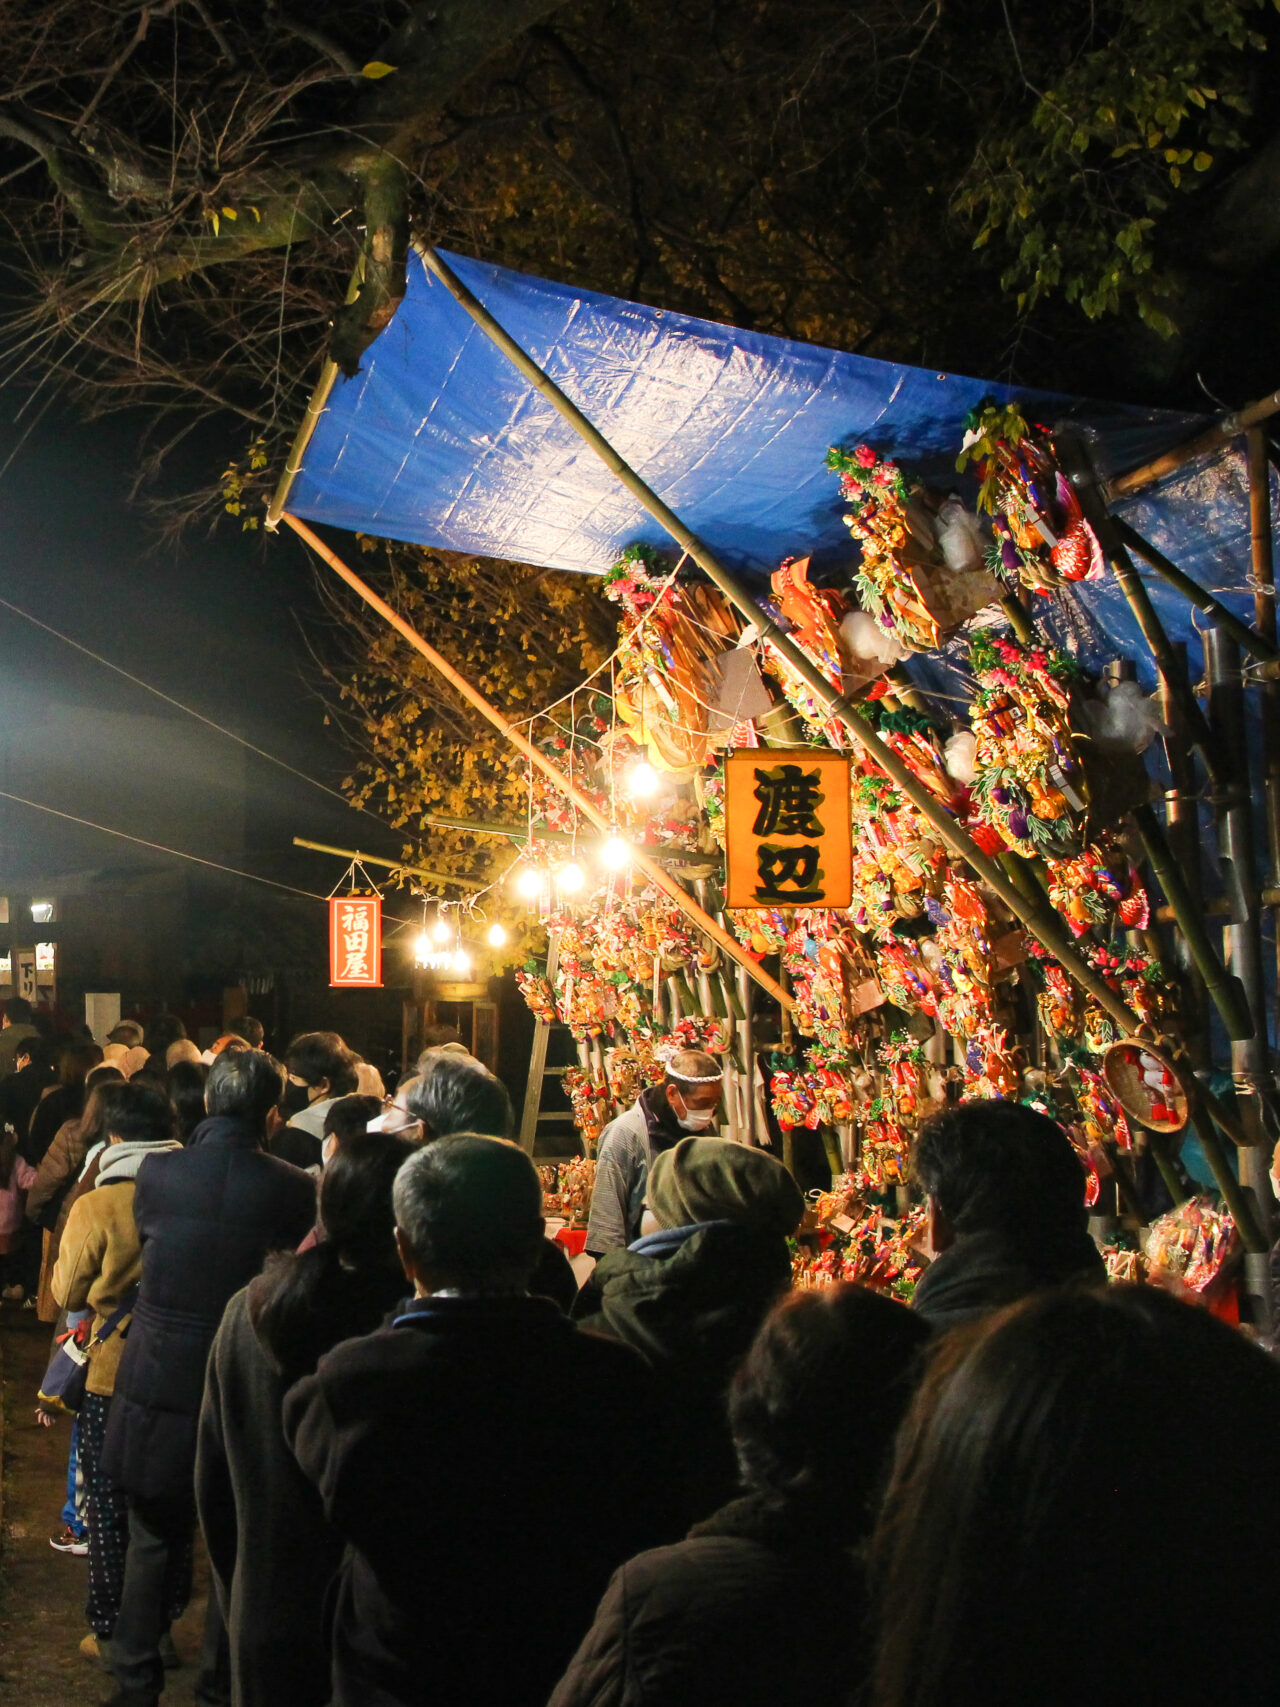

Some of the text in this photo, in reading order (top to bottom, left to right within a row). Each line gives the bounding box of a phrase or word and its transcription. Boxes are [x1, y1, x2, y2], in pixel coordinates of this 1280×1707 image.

[752, 764, 825, 903] 渡辺
[341, 904, 370, 979] 福田屋
[21, 963, 34, 996] 下り
